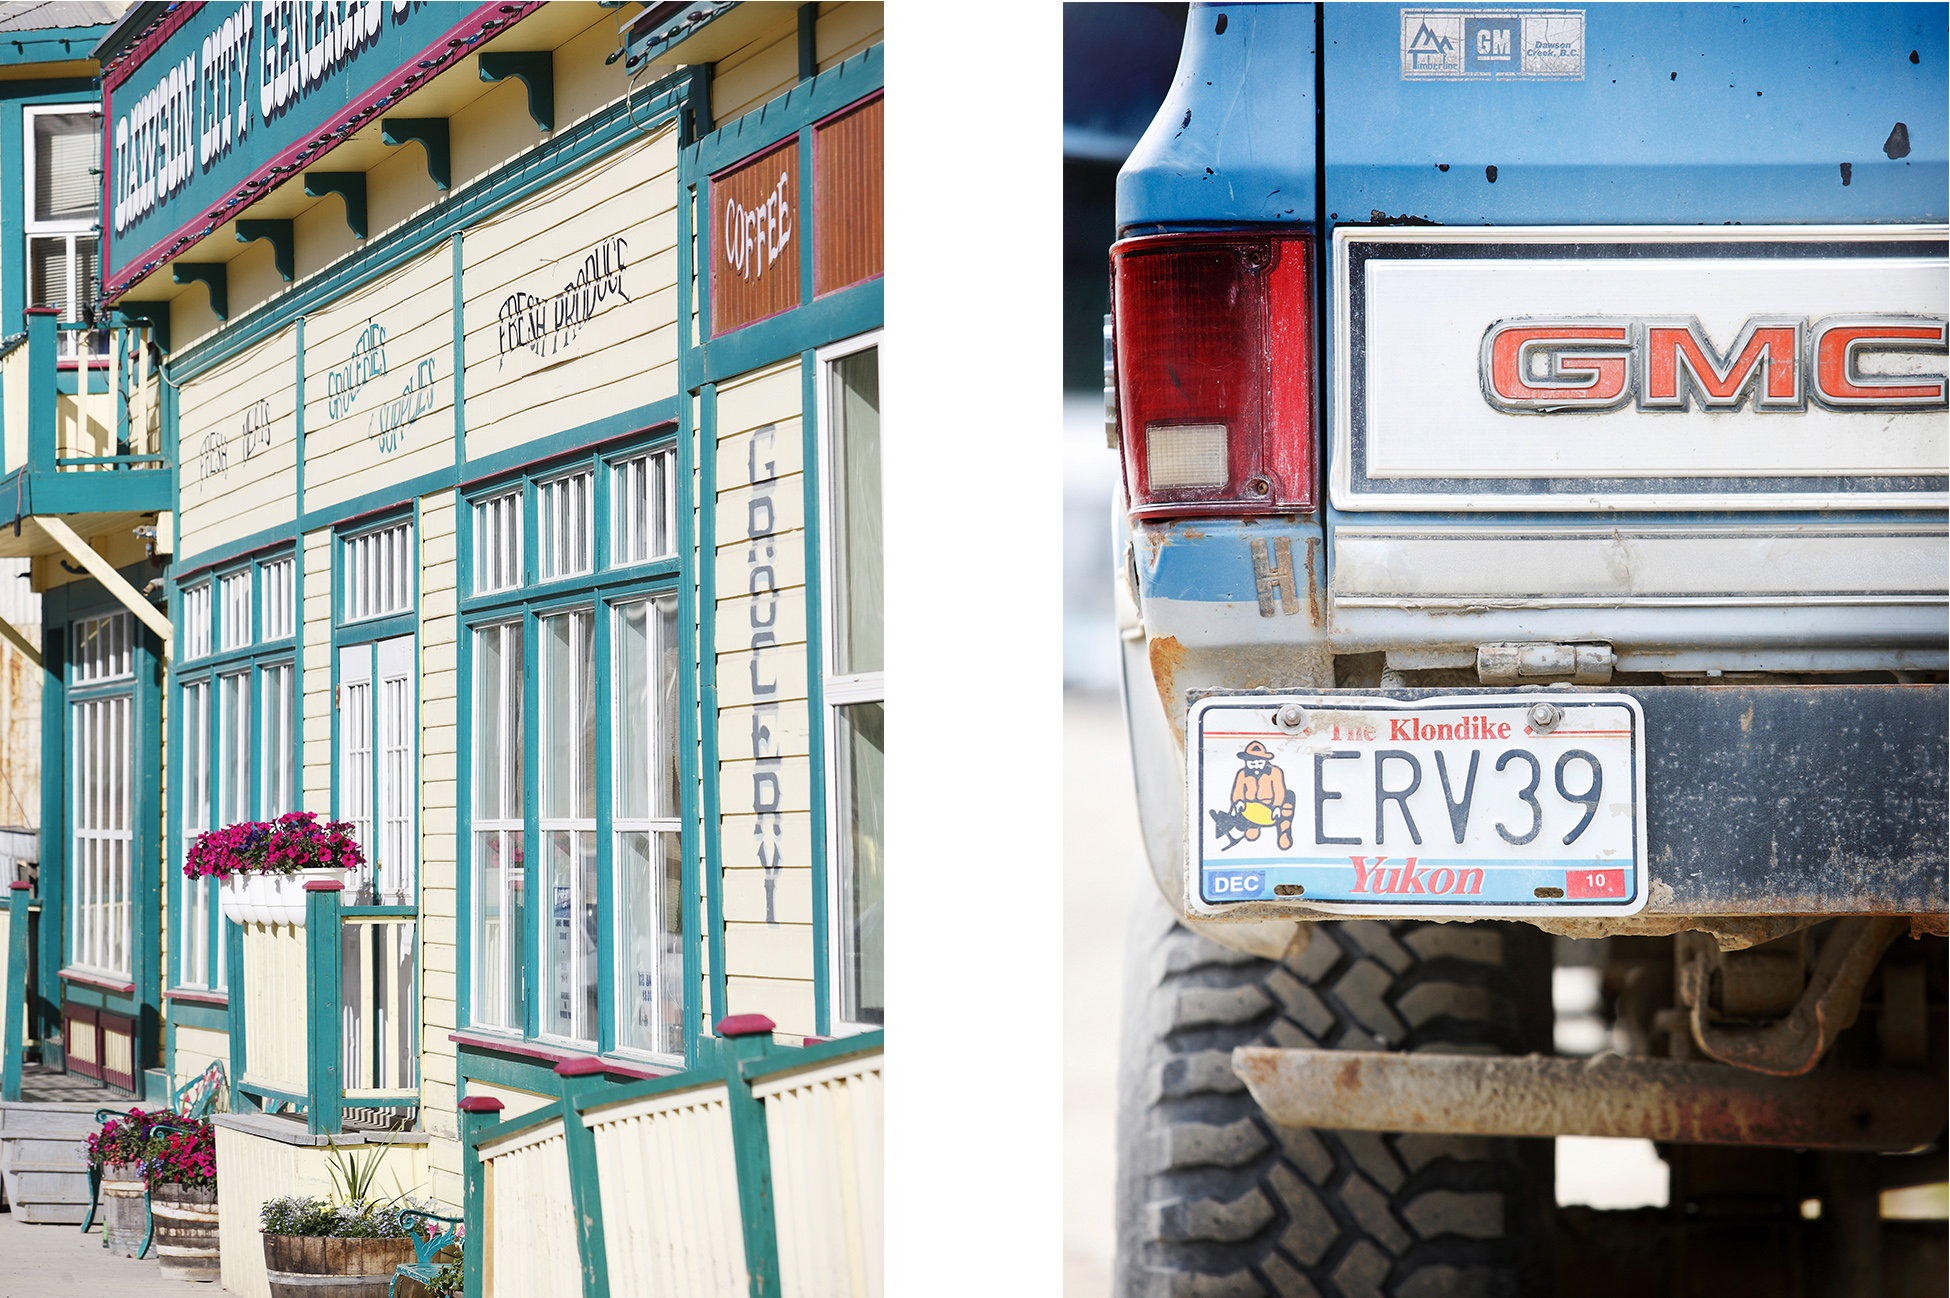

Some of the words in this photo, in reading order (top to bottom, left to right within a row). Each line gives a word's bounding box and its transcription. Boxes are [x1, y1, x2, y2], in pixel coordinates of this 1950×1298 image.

[1407, 50, 1458, 70] Timberline
[1477, 29, 1511, 55] GM
[1527, 49, 1557, 58] Creek,
[1560, 49, 1579, 57] B.C.
[1535, 41, 1571, 49] Dawson
[115, 50, 197, 234] DAWSON
[201, 3, 254, 167] CITY
[260, 3, 383, 118] GENER
[725, 171, 793, 282] COFFEE
[497, 291, 549, 372] FRESH
[551, 236, 632, 356] PRODUCE
[328, 323, 388, 420] GROCERIES
[1478, 313, 1948, 413] GMC
[379, 357, 435, 453] SUPPLIES
[1389, 715, 1512, 742] Klondike
[1313, 749, 1603, 846] ERV39
[1214, 875, 1260, 894] DEC
[1349, 856, 1486, 896] Yukon
[1586, 873, 1606, 887] 10
